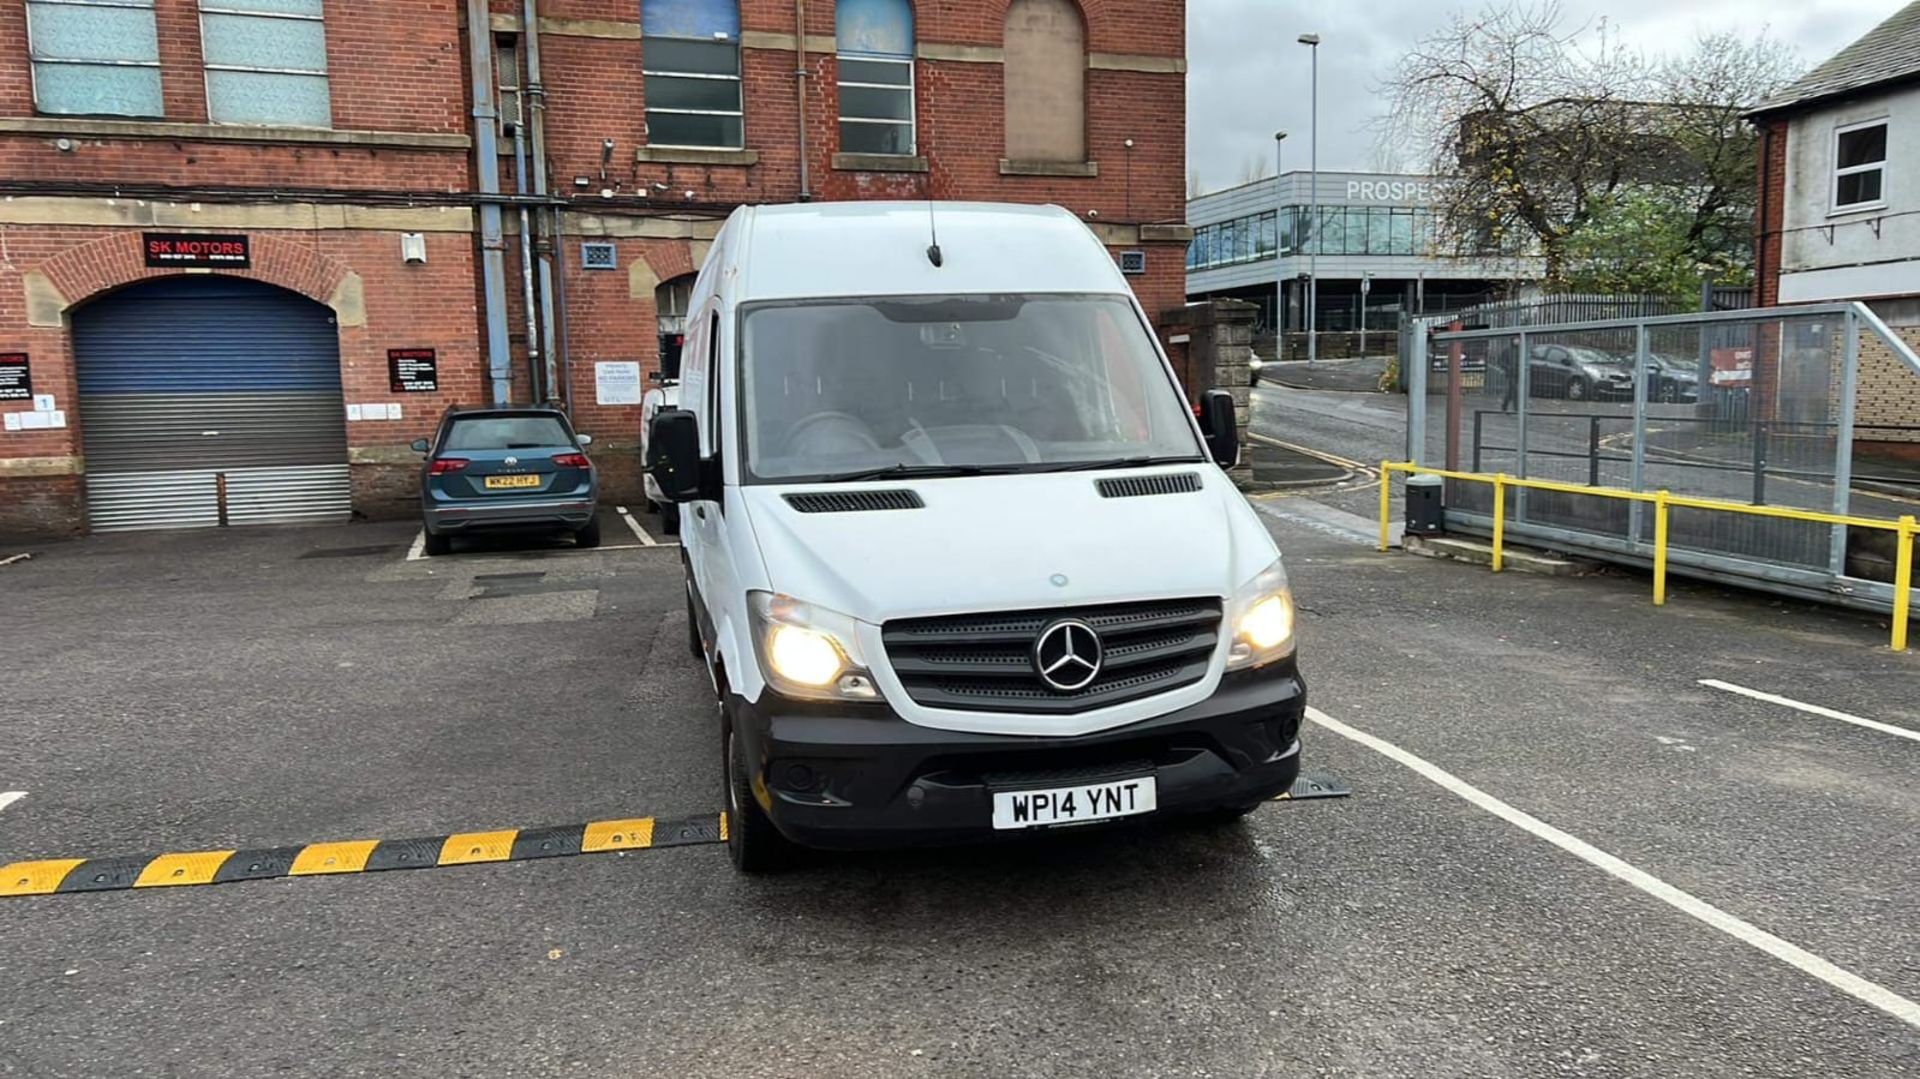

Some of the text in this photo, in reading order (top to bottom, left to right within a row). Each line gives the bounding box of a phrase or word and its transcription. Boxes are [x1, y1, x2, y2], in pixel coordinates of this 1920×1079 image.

[1347, 181, 1453, 201] PROSPEC
[150, 241, 244, 254] SK MOTORS
[1012, 783, 1139, 823] WP14 YNT
